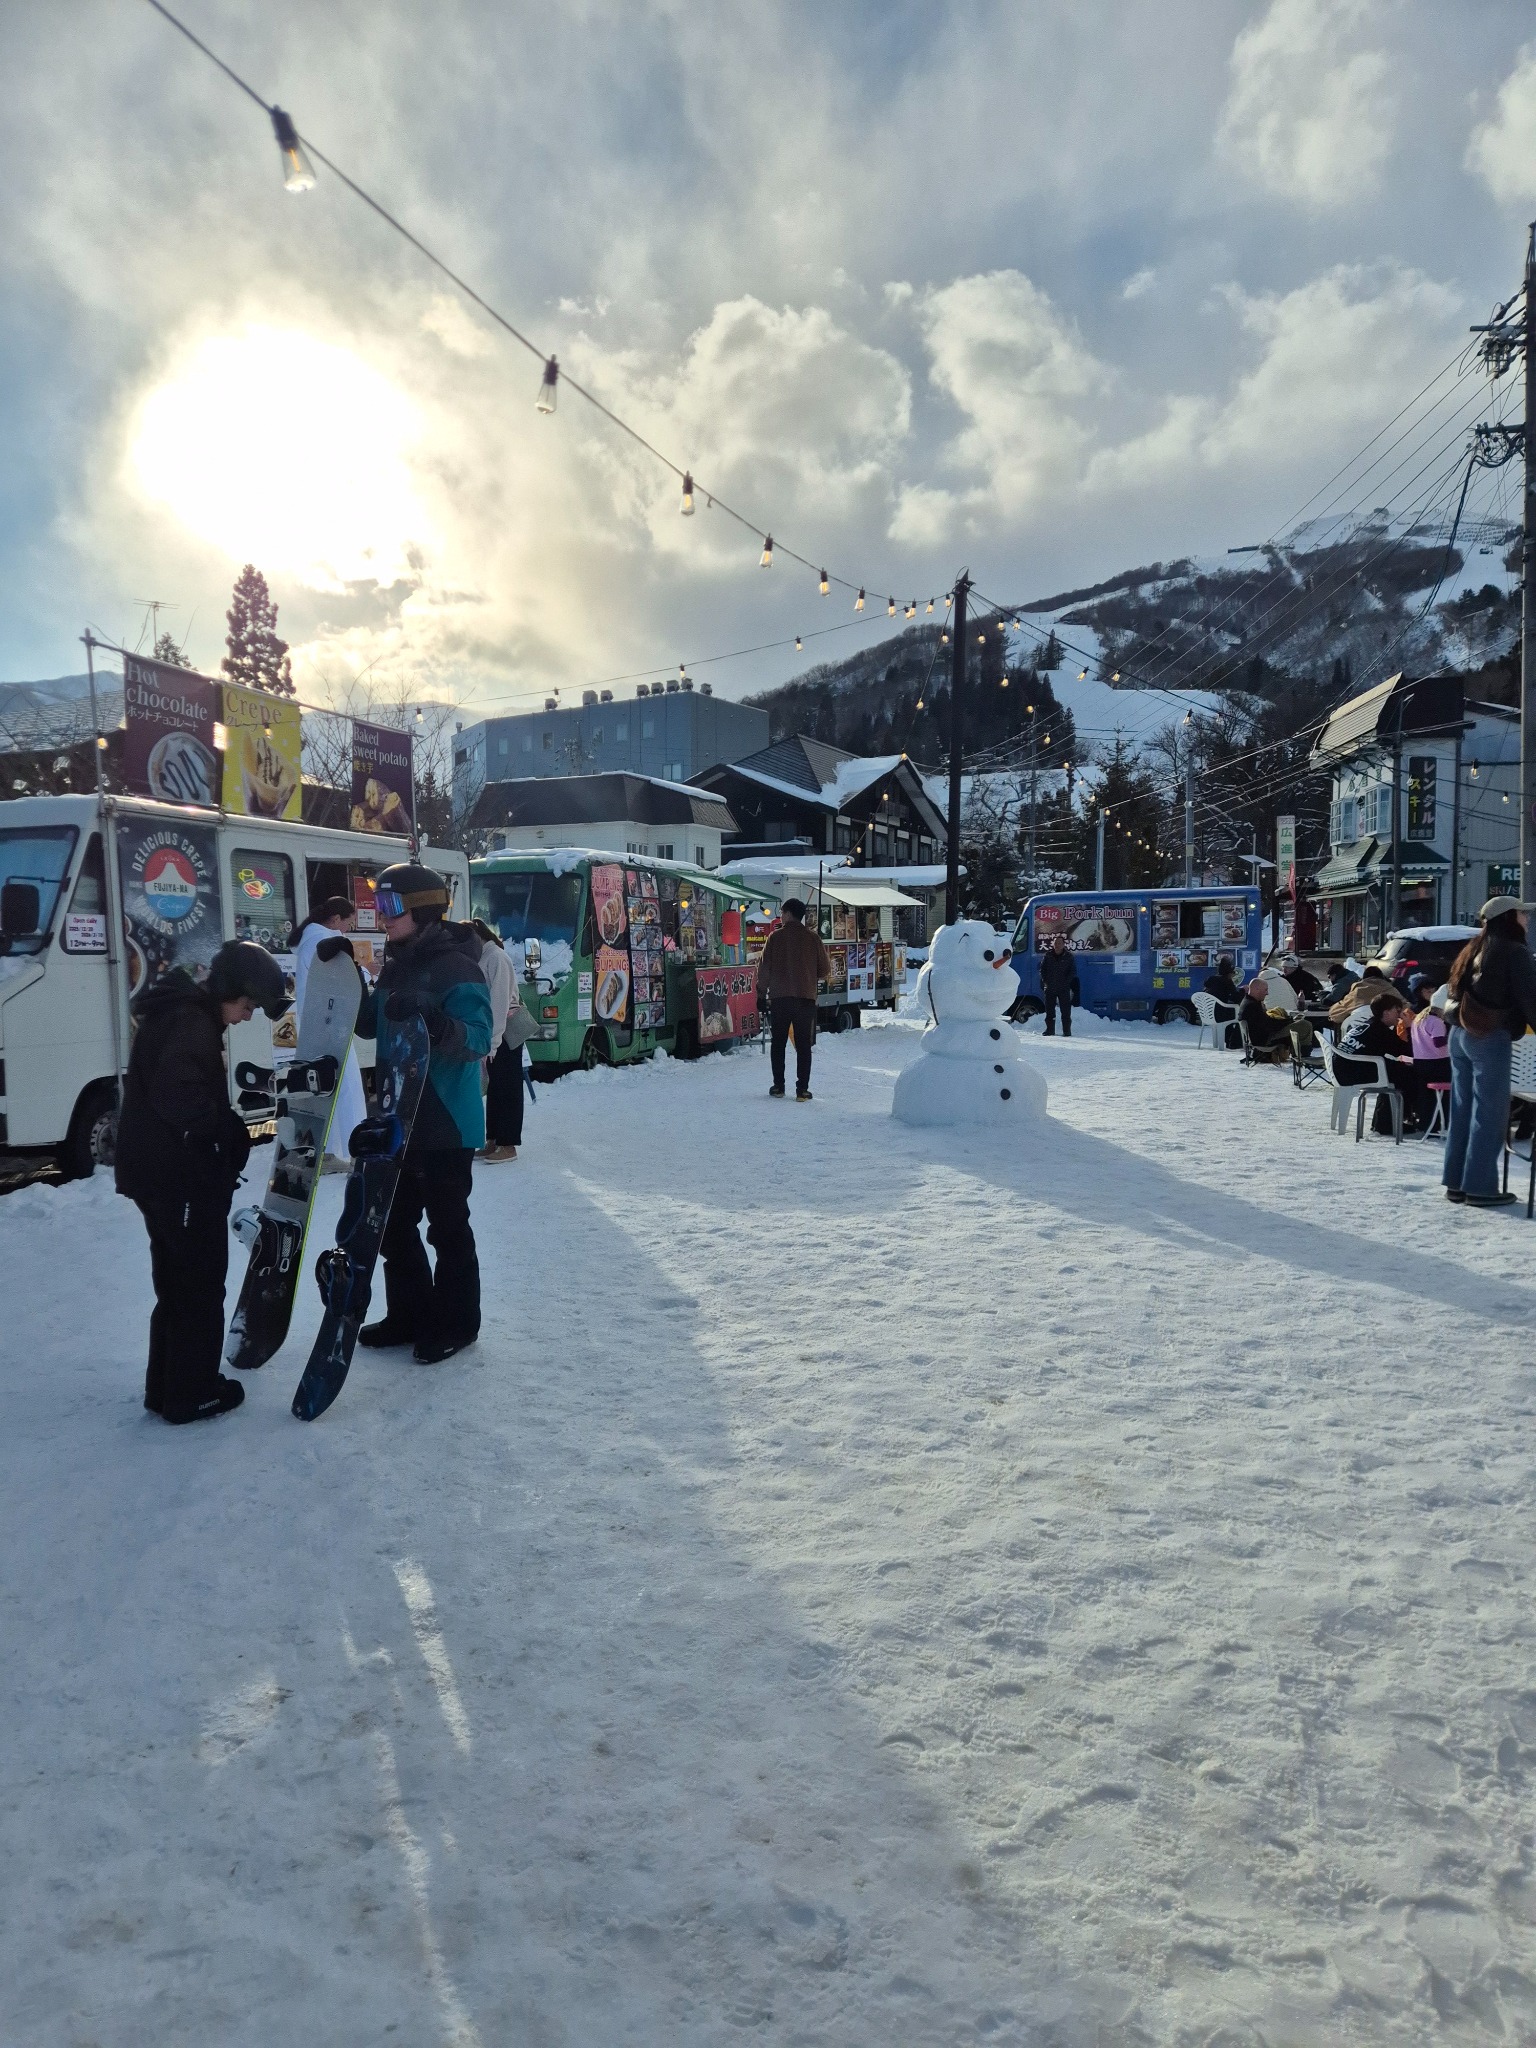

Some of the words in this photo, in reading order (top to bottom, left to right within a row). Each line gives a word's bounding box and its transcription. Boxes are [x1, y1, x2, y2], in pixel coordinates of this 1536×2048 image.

[127, 661, 160, 689] Hot
[126, 685, 208, 721] chocolate
[226, 690, 282, 725] Crepe
[127, 706, 199, 732] ホットチョコレート
[353, 726, 379, 746] Baked
[353, 745, 377, 761] sweet
[379, 751, 408, 767] potato
[1410, 778, 1421, 824] スキー
[1424, 761, 1436, 825] レンタル
[132, 831, 178, 872] DELICIOUS
[181, 838, 207, 878] CREPE
[177, 899, 206, 935] FINEST
[1040, 909, 1059, 920] Big
[1064, 905, 1103, 920] Pork
[1104, 905, 1135, 919] bun
[1039, 938, 1093, 950] 大肉まん
[698, 974, 729, 999] らーめん
